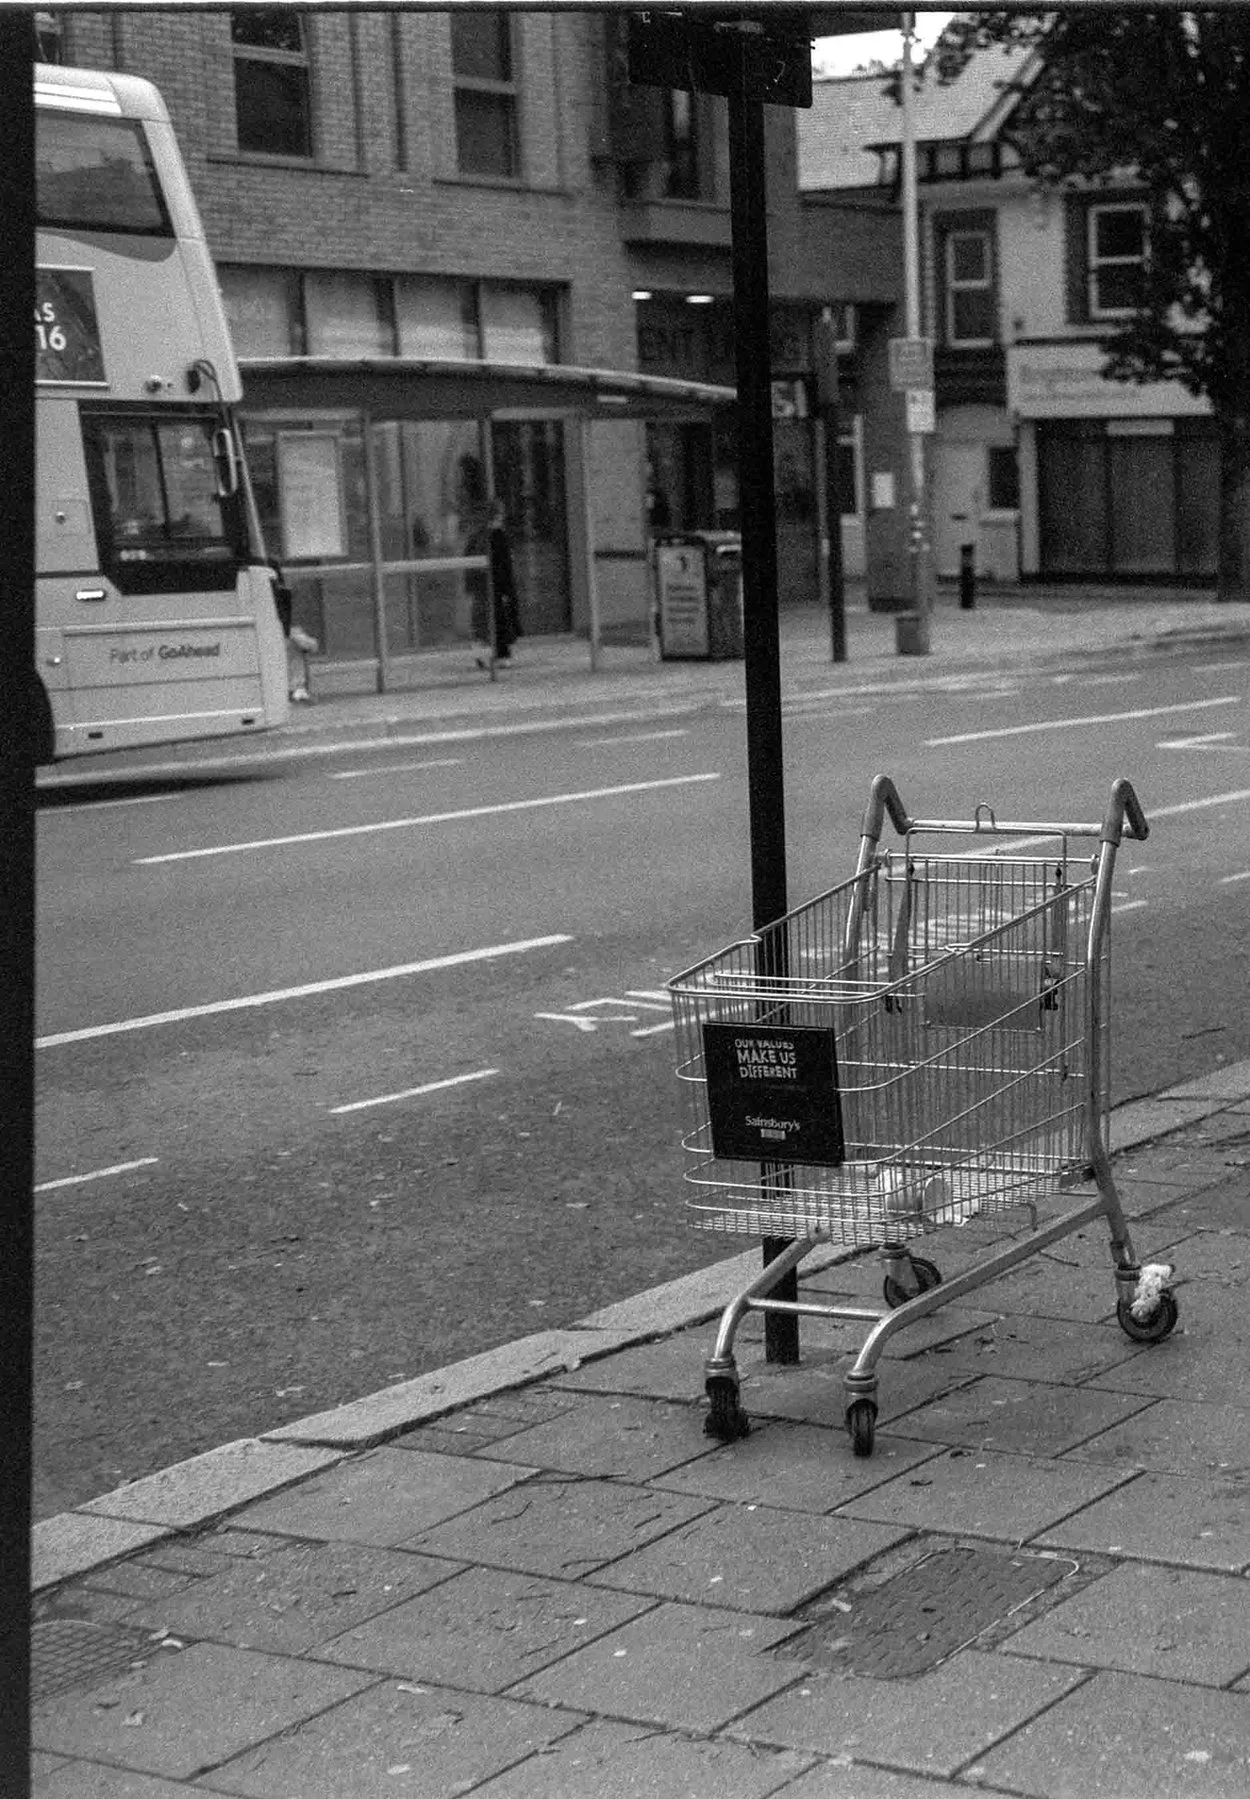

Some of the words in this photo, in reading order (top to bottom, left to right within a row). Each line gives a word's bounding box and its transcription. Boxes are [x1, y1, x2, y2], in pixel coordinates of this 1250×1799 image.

[736, 1049, 777, 1065] MAKE
[779, 1051, 797, 1066] US
[739, 1064, 798, 1080] DIFFERENT
[744, 1114, 801, 1133] Sainsbury's
